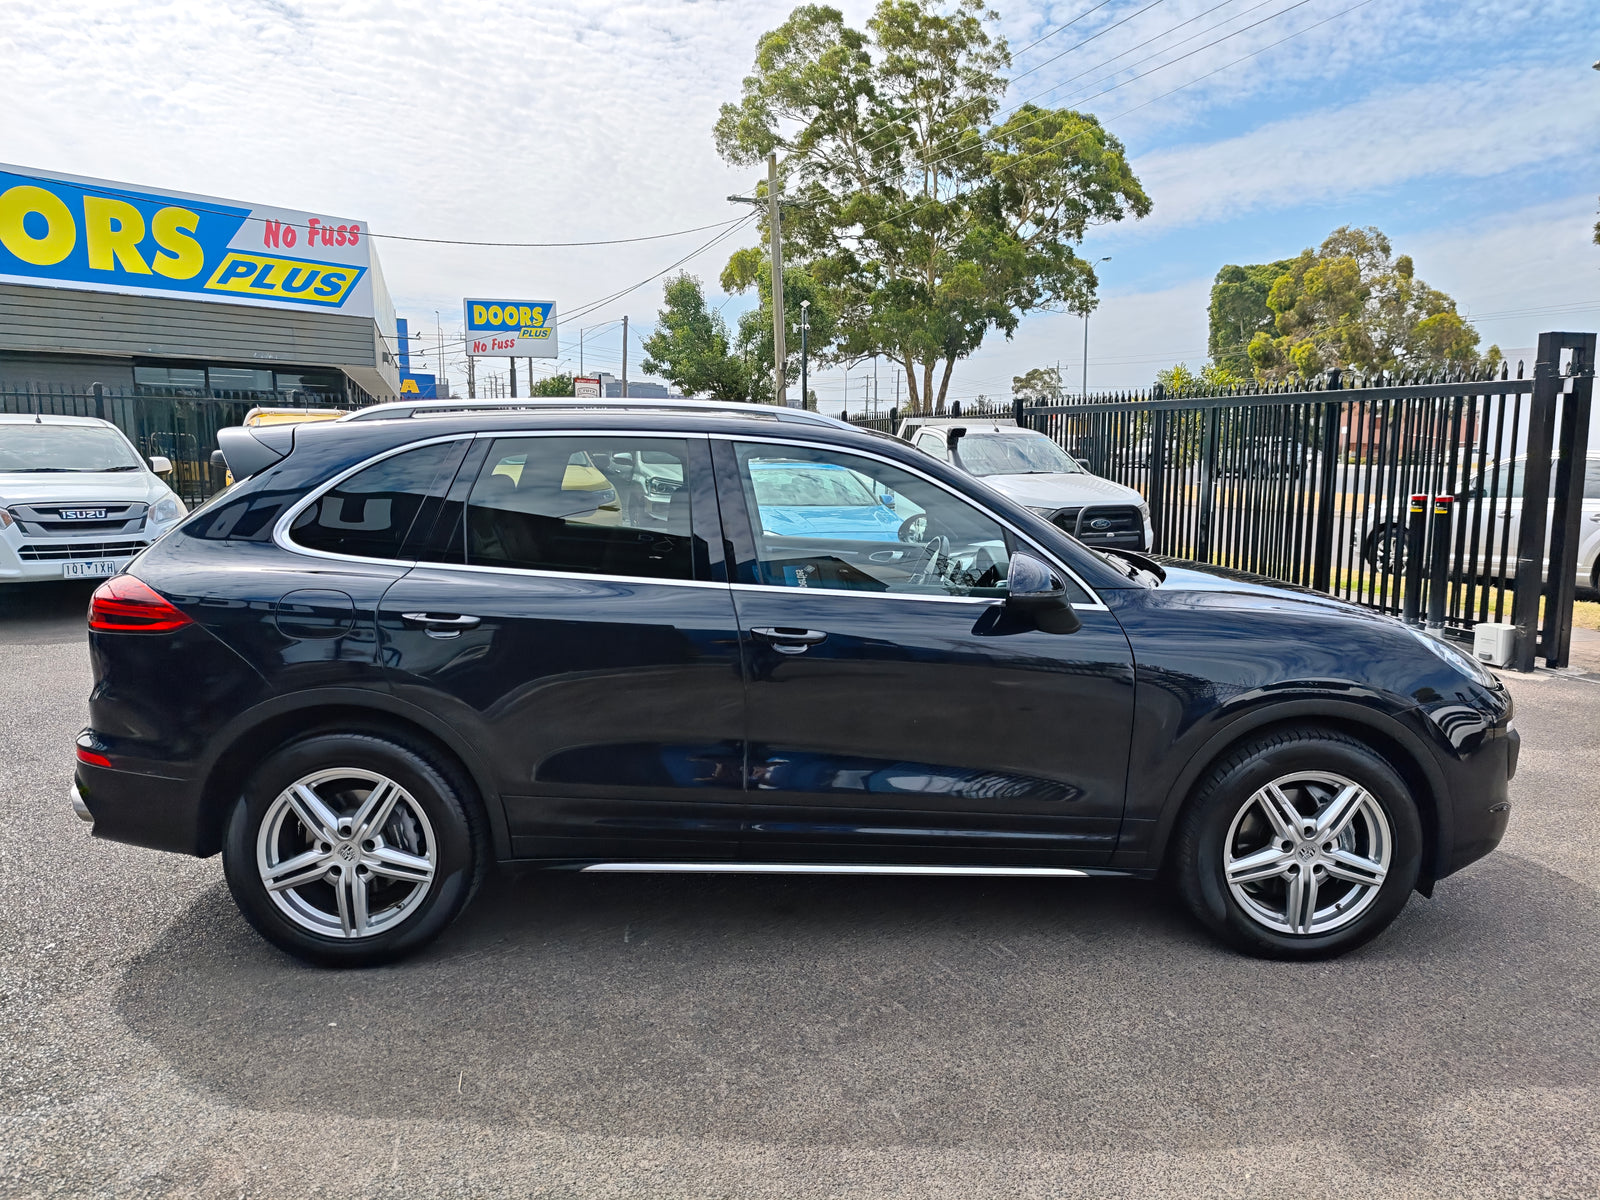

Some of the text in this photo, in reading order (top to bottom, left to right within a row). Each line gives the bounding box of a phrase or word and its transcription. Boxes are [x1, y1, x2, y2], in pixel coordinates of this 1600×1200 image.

[0, 185, 205, 280] ORS
[263, 217, 361, 249] No Fuss
[216, 259, 348, 297] PLUS
[473, 304, 544, 327] DOORS
[521, 328, 549, 338] PLUS
[473, 338, 516, 354] No Fuss
[62, 510, 106, 519] ISUZU
